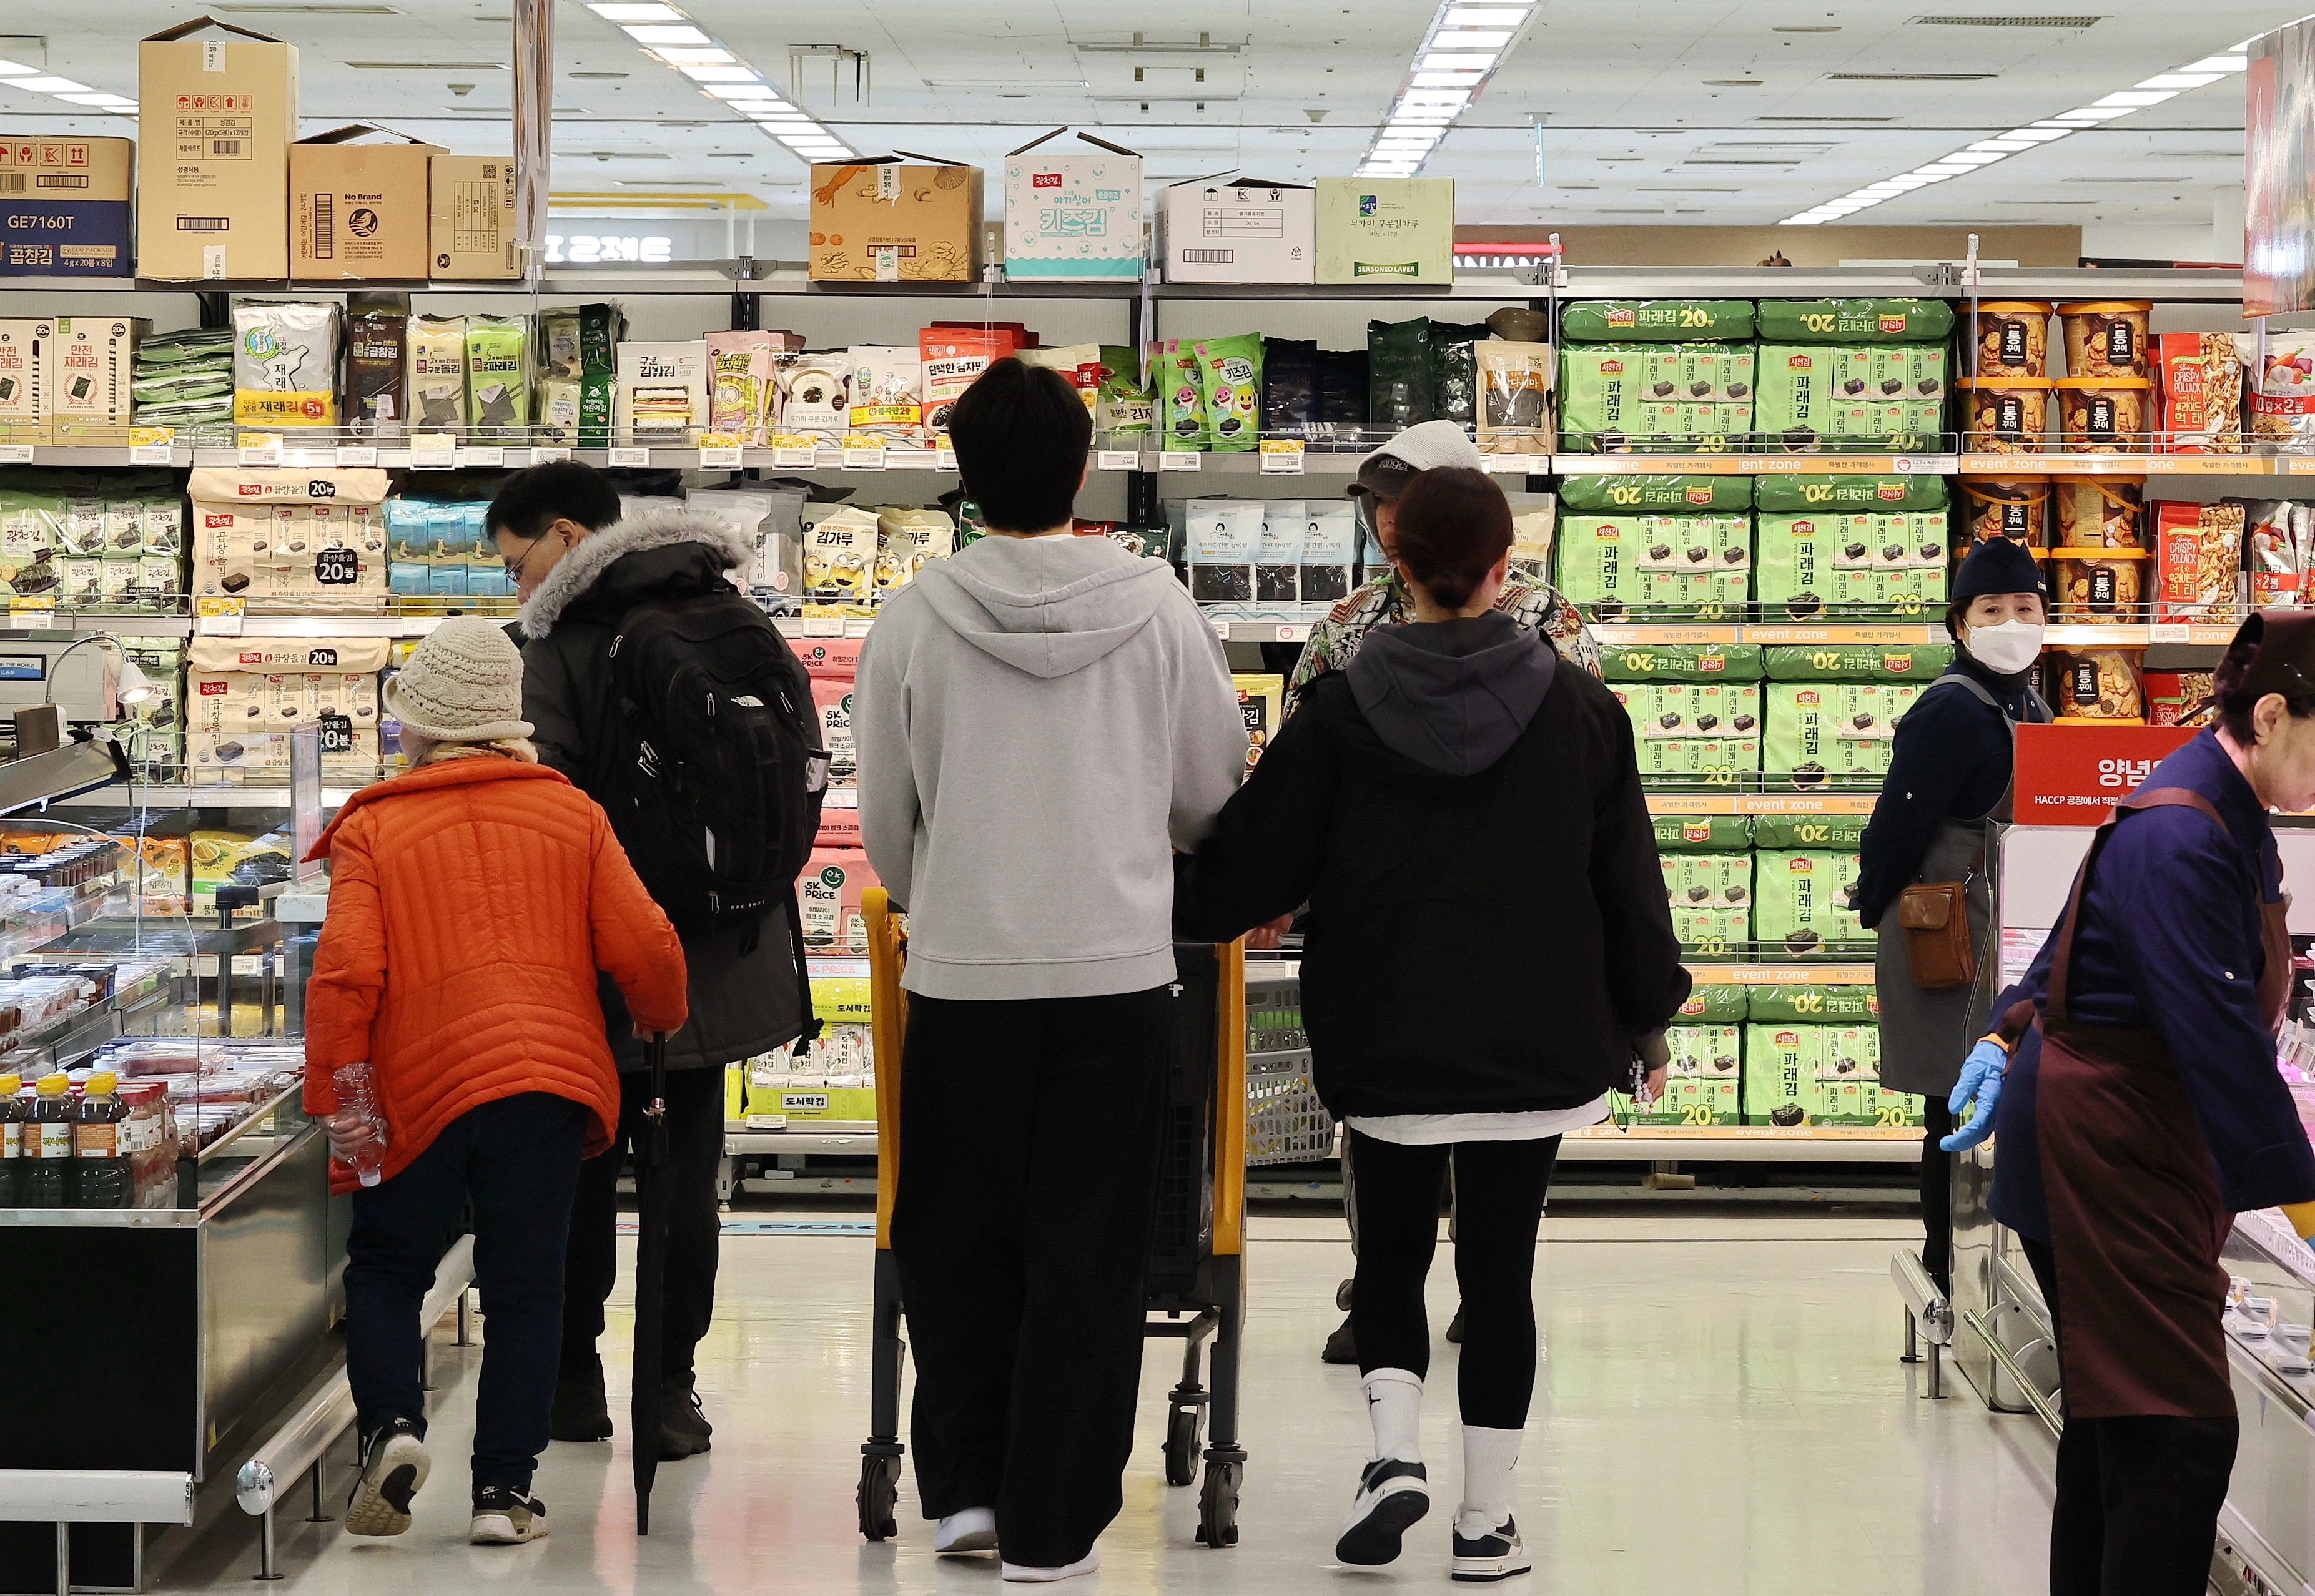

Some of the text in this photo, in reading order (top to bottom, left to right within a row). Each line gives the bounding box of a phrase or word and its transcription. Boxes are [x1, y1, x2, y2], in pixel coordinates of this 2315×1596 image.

[1054, 195, 1091, 206] 아기상어
[7, 215, 74, 229] GE7160T
[1040, 209, 1107, 236] 키즈김
[9, 249, 53, 265] 곱창김
[1610, 312, 1632, 322] 서천김
[1638, 309, 1677, 323] 파래김
[1839, 320, 1875, 332] 파래김
[2006, 330, 2021, 343] 통
[2113, 330, 2128, 344] 통
[71, 345, 92, 356] 만전
[2006, 344, 2021, 353] 꾸이
[2113, 344, 2128, 353] 꾸이
[64, 356, 99, 368] 재래김
[489, 361, 517, 371] 파래김
[1790, 357, 1811, 367] 서천김
[1225, 365, 1253, 378] 키즈김
[2174, 371, 2200, 382] CRISPY
[275, 364, 286, 392] 재래
[2174, 383, 2201, 393] POLLACK
[1607, 380, 1622, 421] 파래김
[1795, 376, 1810, 418] 파래김
[259, 401, 299, 412] 재래김
[2175, 401, 2202, 412] 후라이드
[2002, 406, 2018, 420] 통
[2093, 406, 2109, 421] 통
[2093, 421, 2108, 430] 꾸이
[1769, 460, 1801, 470] zone
[1970, 459, 2046, 470] event zone
[273, 485, 307, 495] 곱창돌김
[2008, 517, 2023, 525] 꾸이
[817, 532, 854, 546] 김가루
[2169, 543, 2197, 554] CRISPY
[216, 531, 227, 578] 곱창돌김
[2169, 553, 2196, 564] POLLACK
[1604, 546, 1619, 589] 파래김
[1800, 541, 1814, 586] 파래김
[318, 563, 355, 580] 20봉
[2095, 576, 2110, 591] 통
[2168, 573, 2195, 584] 후라이드
[2094, 591, 2109, 600] 꾸이
[1750, 629, 1828, 639] event zone
[2194, 631, 2228, 641] zone
[273, 654, 307, 663] 곱창돌김
[311, 651, 335, 665] 20봉
[2078, 669, 2091, 684] 통
[826, 711, 841, 719] 5K
[210, 699, 222, 745] 곱창돌김
[826, 720, 849, 728] PRIC
[1805, 712, 1819, 756] 파래김
[2098, 759, 2162, 787] 양념
[1745, 800, 1823, 810] event zone
[2035, 795, 2120, 805] HACCP 공장에서 직접
[805, 882, 821, 890] 5K
[805, 890, 836, 900] PRICE
[1798, 879, 1812, 922] 파래김
[822, 965, 856, 974] PRICE
[1732, 970, 1809, 980] event zone
[1784, 1053, 1798, 1096] 파래김
[786, 1097, 824, 1105] 도시락김
[1736, 1128, 1812, 1138] event zone
